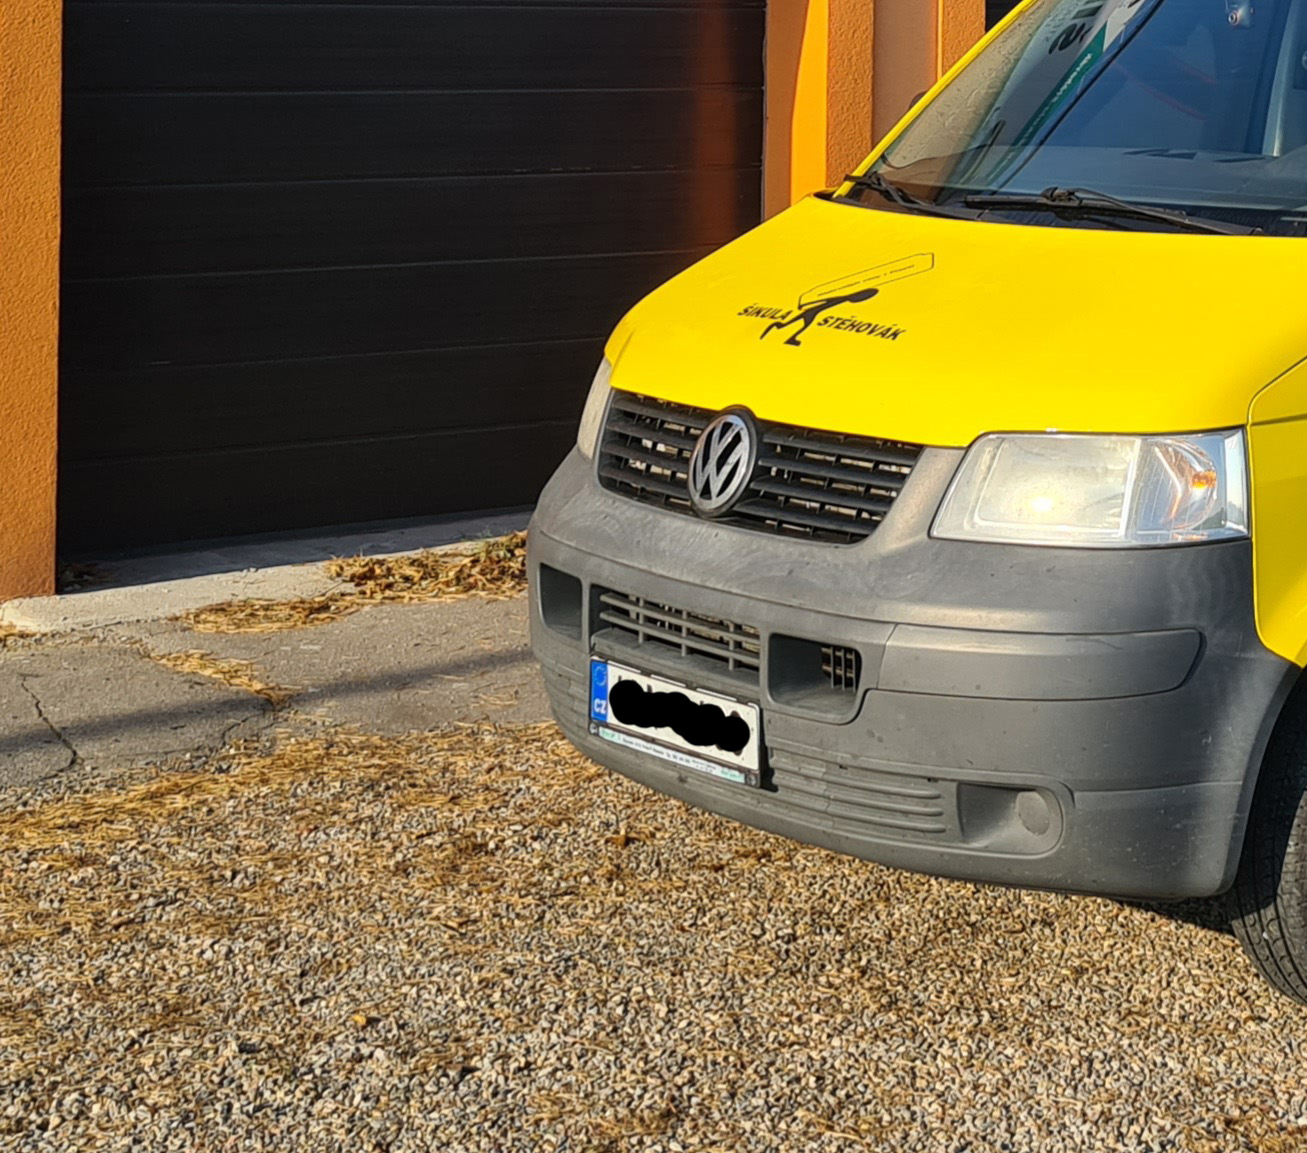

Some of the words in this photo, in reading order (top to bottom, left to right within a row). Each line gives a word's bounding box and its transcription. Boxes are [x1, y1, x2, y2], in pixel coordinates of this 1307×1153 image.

[737, 302, 791, 323] ŠIKULA
[817, 315, 908, 342] STĚHOVÁK
[593, 697, 607, 715] CZ
